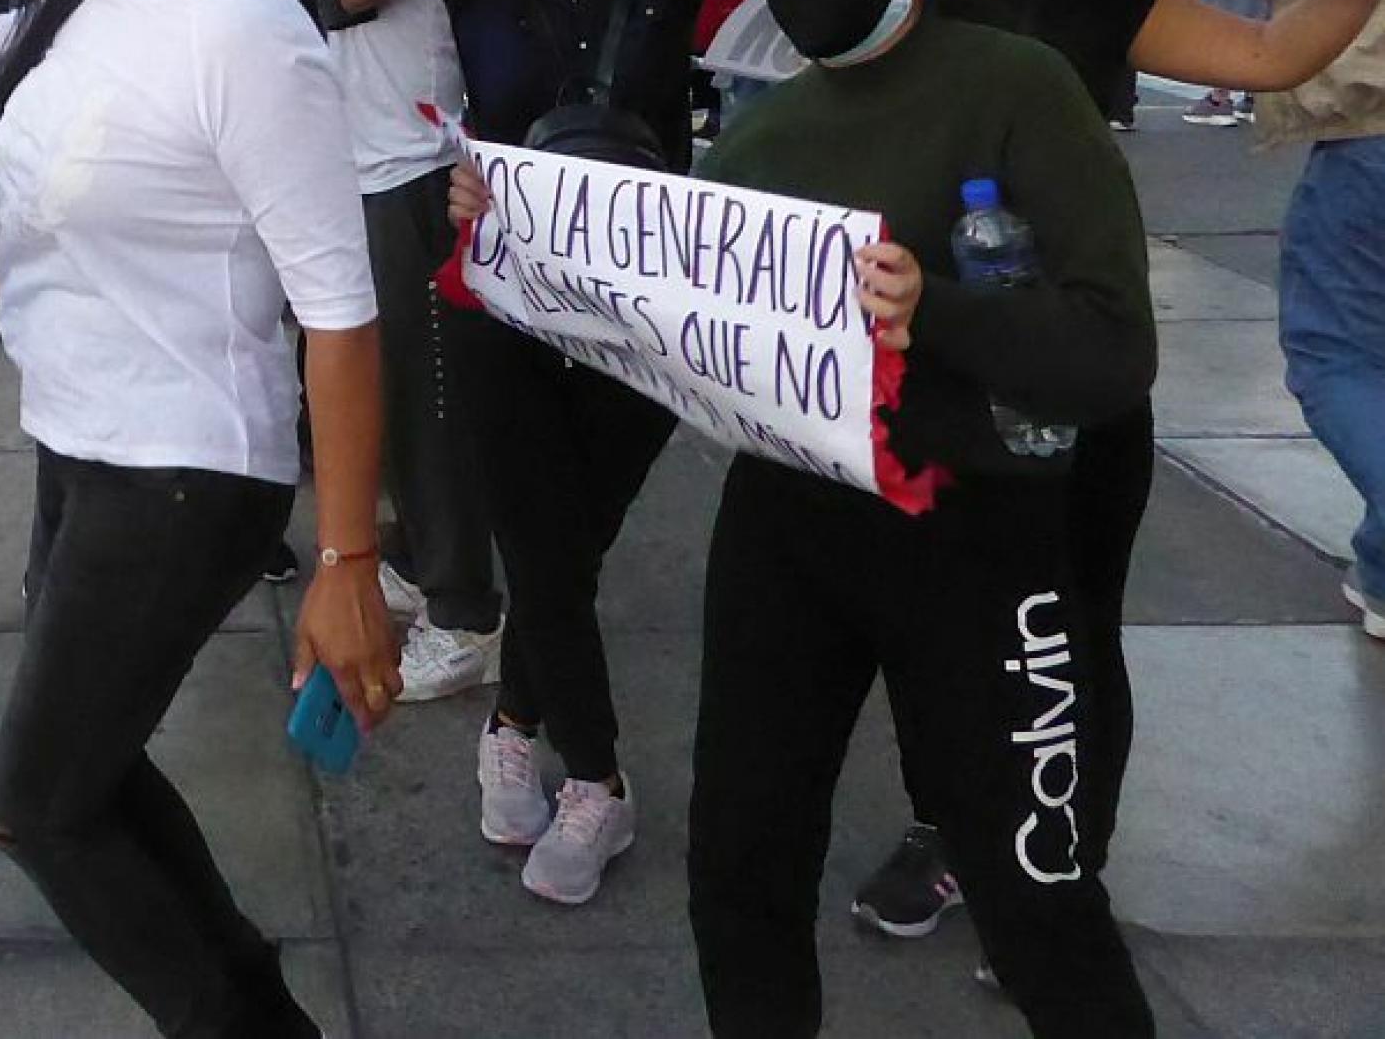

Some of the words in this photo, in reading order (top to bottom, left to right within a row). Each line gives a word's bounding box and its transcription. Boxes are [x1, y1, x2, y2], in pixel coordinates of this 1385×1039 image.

[550, 166, 592, 266] LA
[680, 311, 756, 398] QUE
[776, 331, 844, 421] NO
[1004, 590, 1081, 883] Calvin
